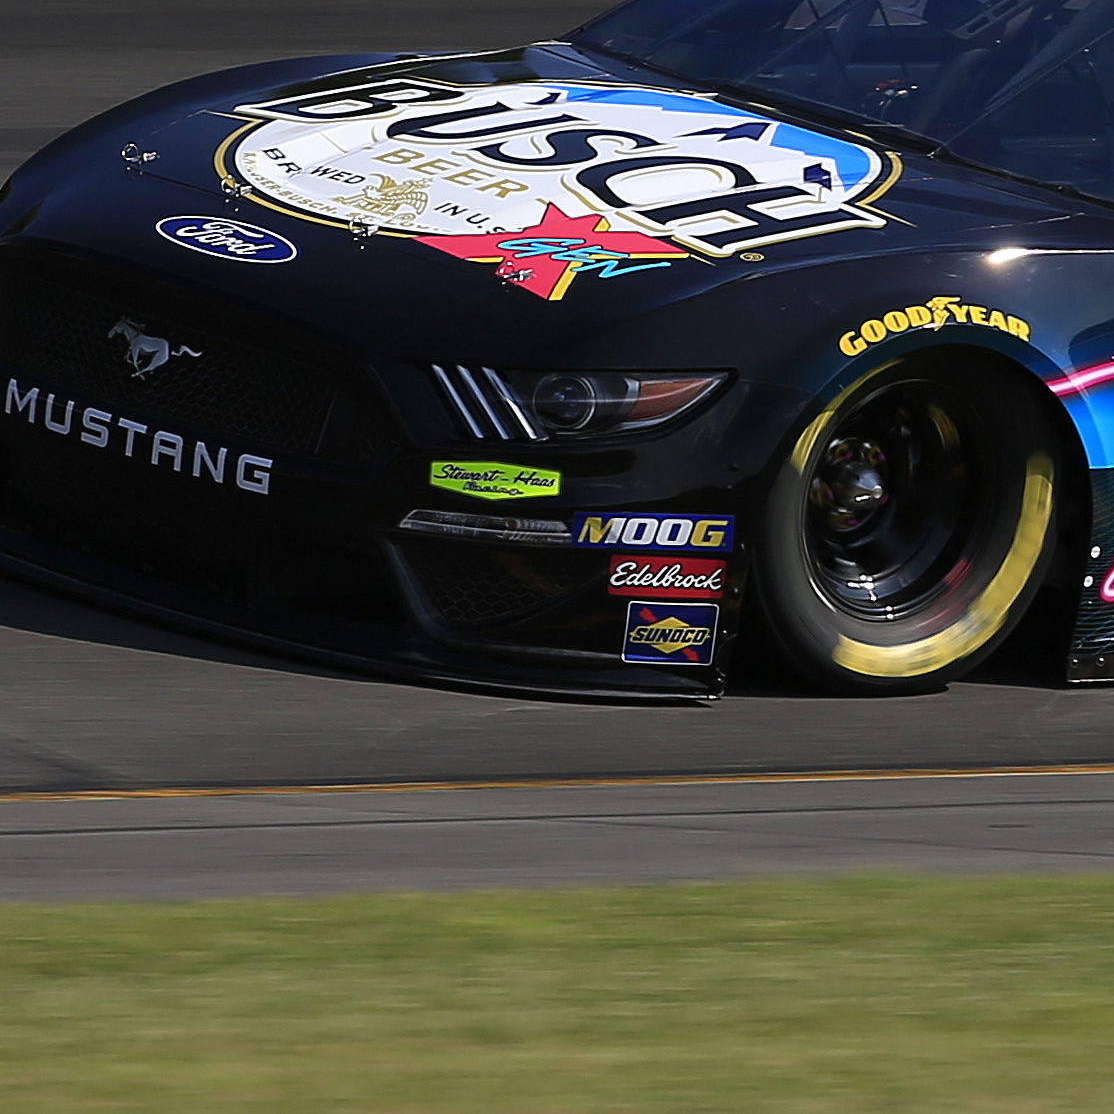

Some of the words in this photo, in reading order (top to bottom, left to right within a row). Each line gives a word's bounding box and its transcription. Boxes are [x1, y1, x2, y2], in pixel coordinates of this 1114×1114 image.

[234, 78, 888, 257] BUSCH
[261, 146, 366, 186] BRWED
[433, 201, 468, 217] IN
[371, 146, 530, 200] BEER
[175, 220, 275, 255] Ford
[497, 237, 673, 279] GEN
[4, 378, 274, 495] MUSTANG
[577, 517, 730, 547] MOOG
[609, 561, 722, 591] Edelbrock
[631, 625, 710, 645] SUNOCO
